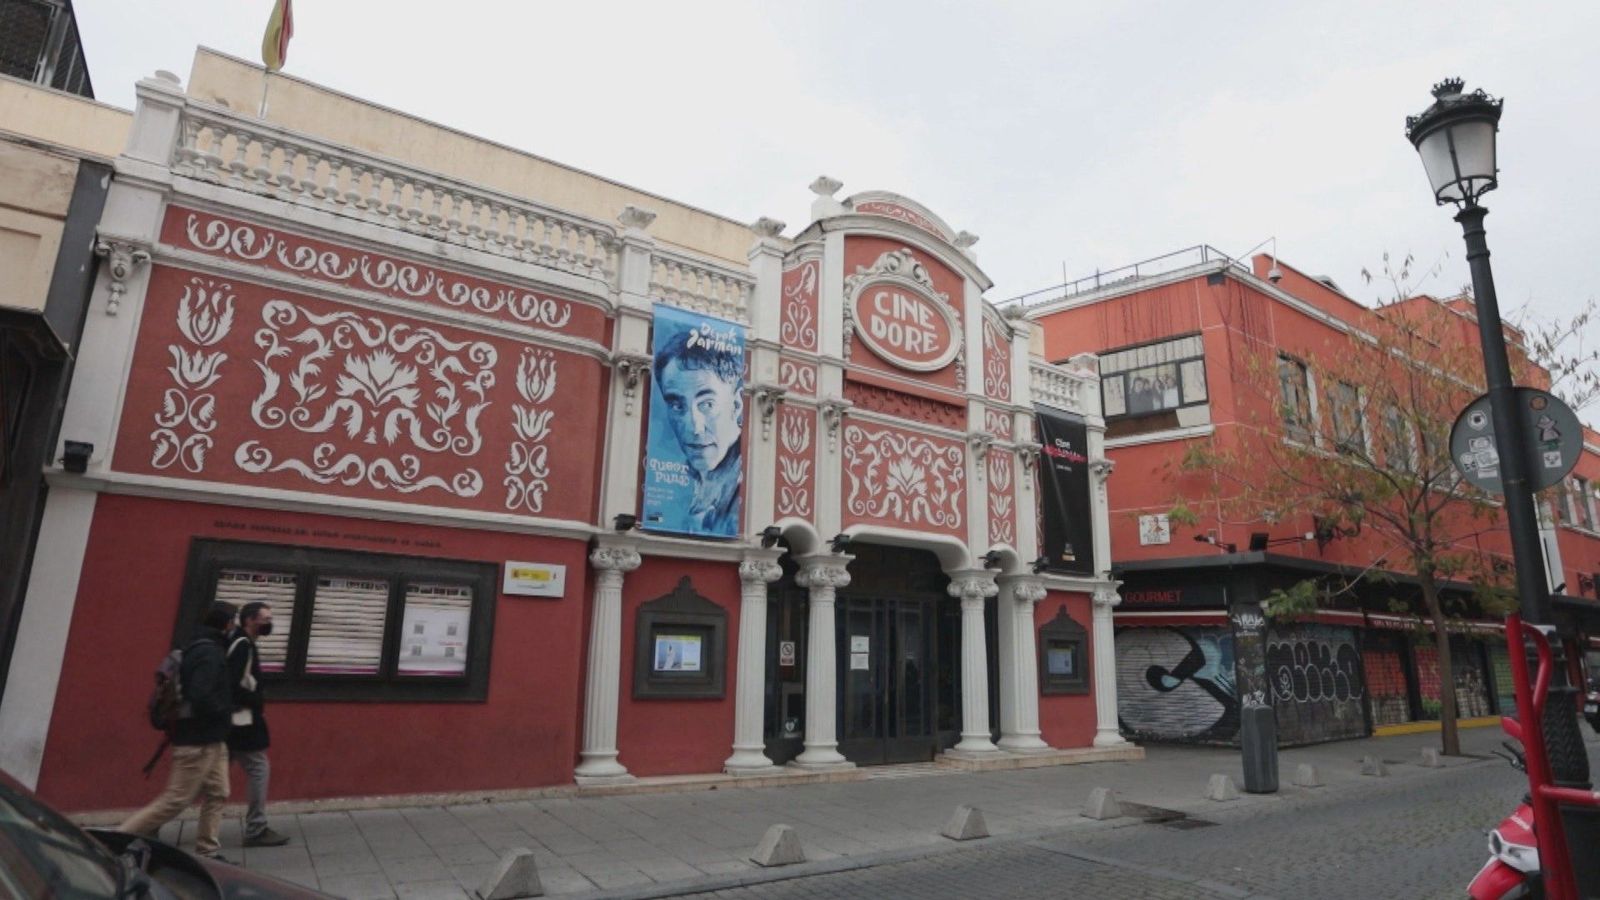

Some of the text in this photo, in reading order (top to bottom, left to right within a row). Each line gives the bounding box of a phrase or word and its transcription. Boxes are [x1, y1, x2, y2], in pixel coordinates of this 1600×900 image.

[874, 291, 935, 331] CINE
[686, 328, 742, 355] Jarman
[700, 322, 737, 344] Derek
[871, 314, 939, 354] DORE
[1124, 589, 1182, 605] GOURMET
